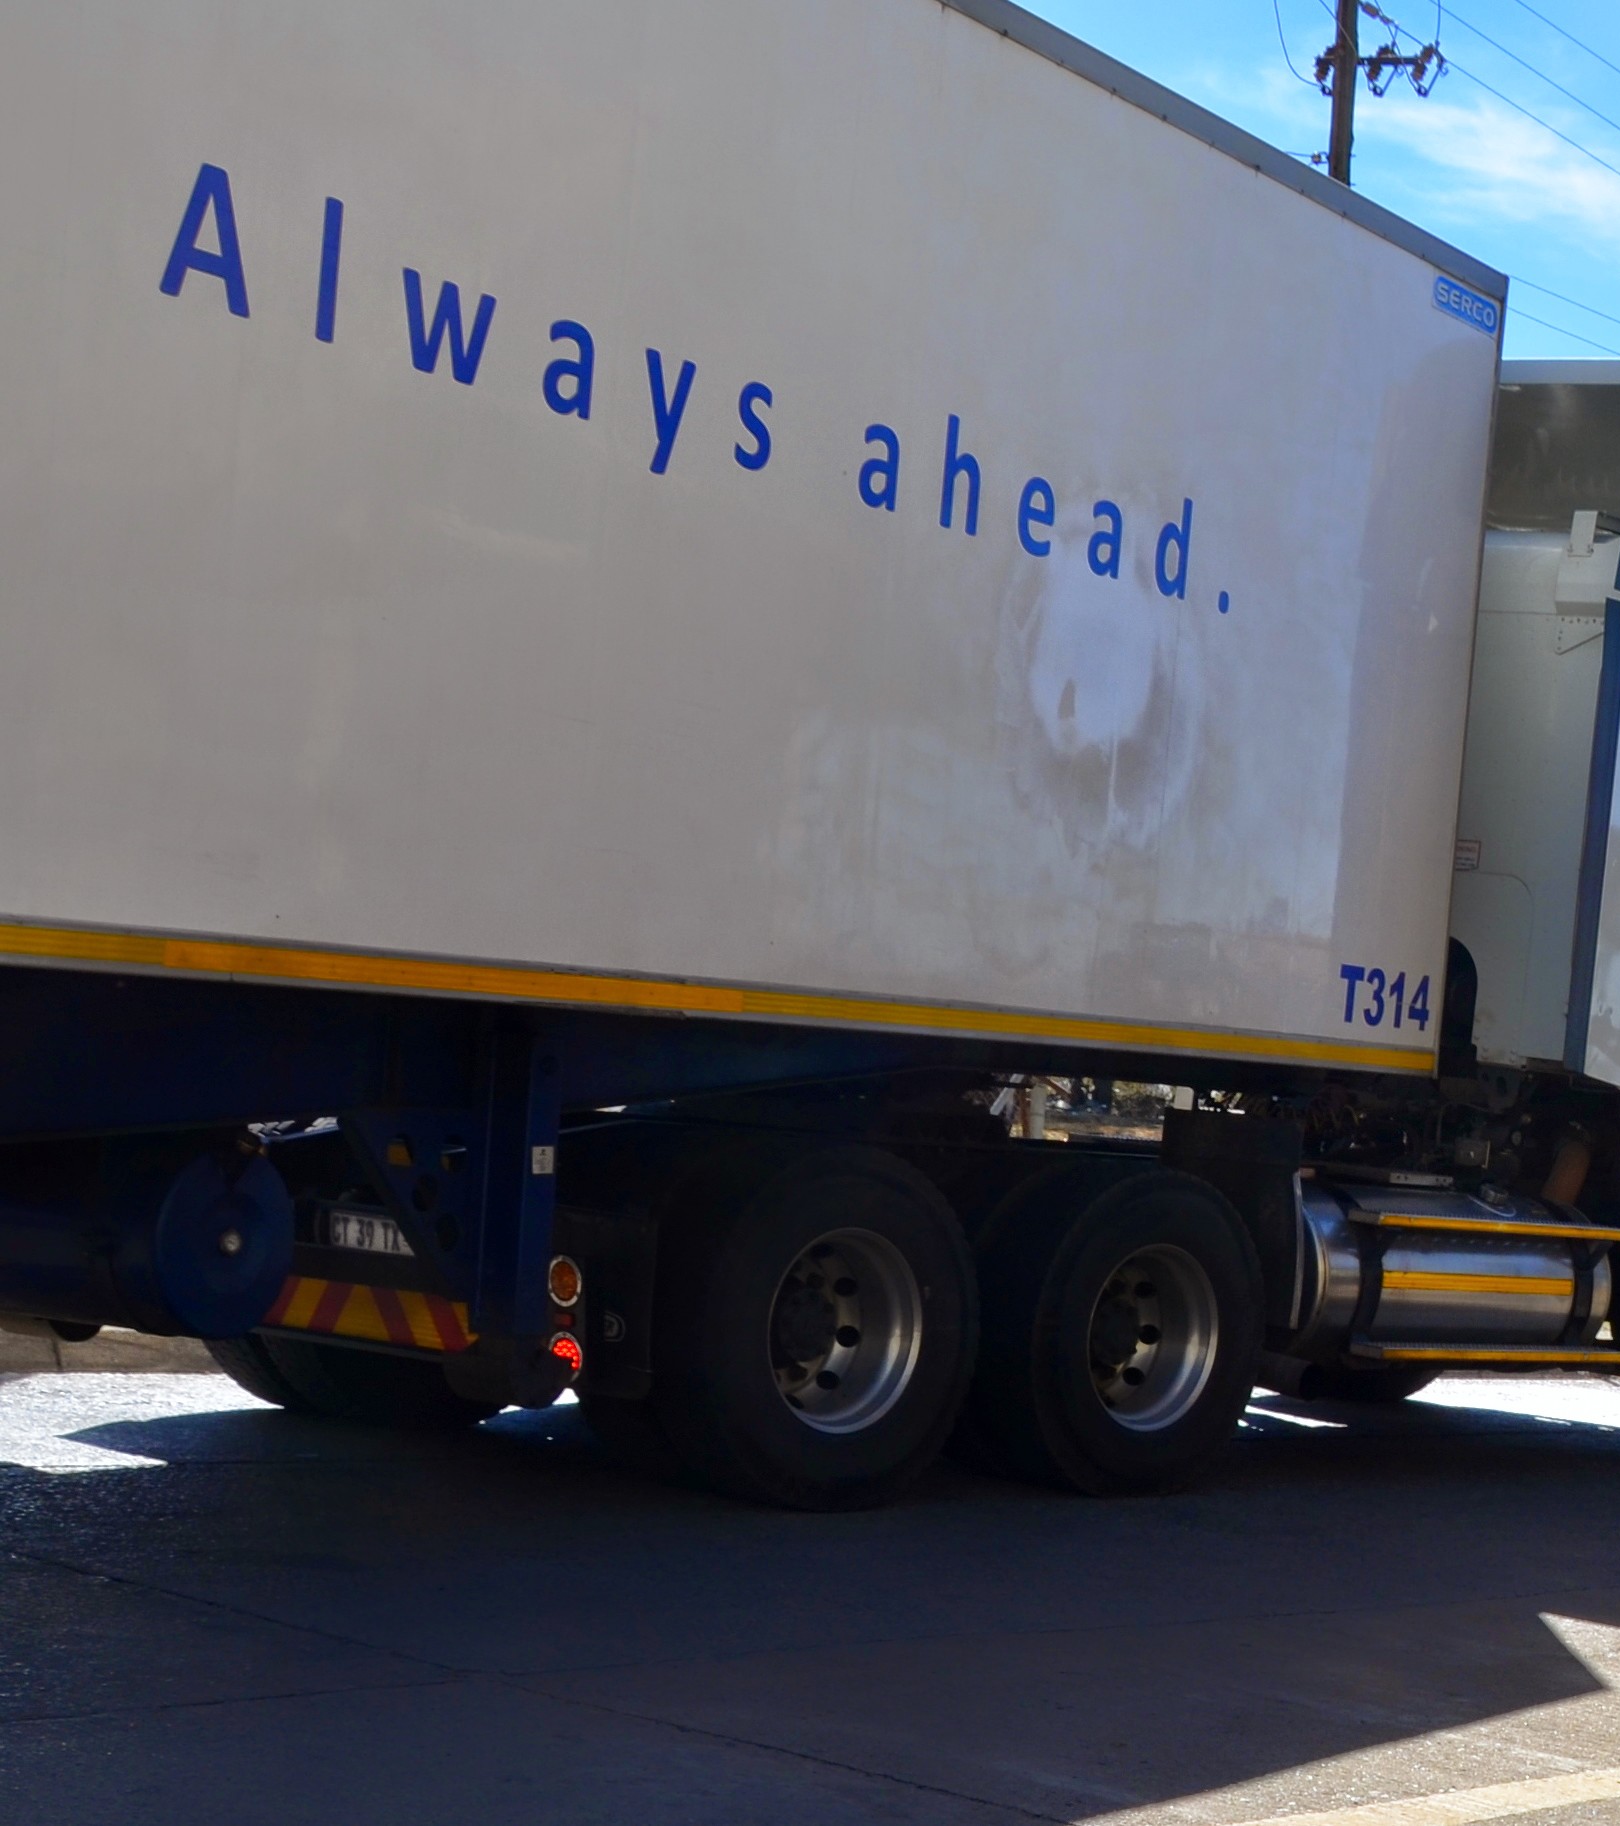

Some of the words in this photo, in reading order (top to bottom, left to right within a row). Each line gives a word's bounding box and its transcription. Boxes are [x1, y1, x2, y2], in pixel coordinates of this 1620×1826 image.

[1436, 283, 1495, 328] SERCO
[159, 162, 773, 476] Always
[857, 412, 1230, 615] ahead.
[1340, 963, 1430, 1031] T314
